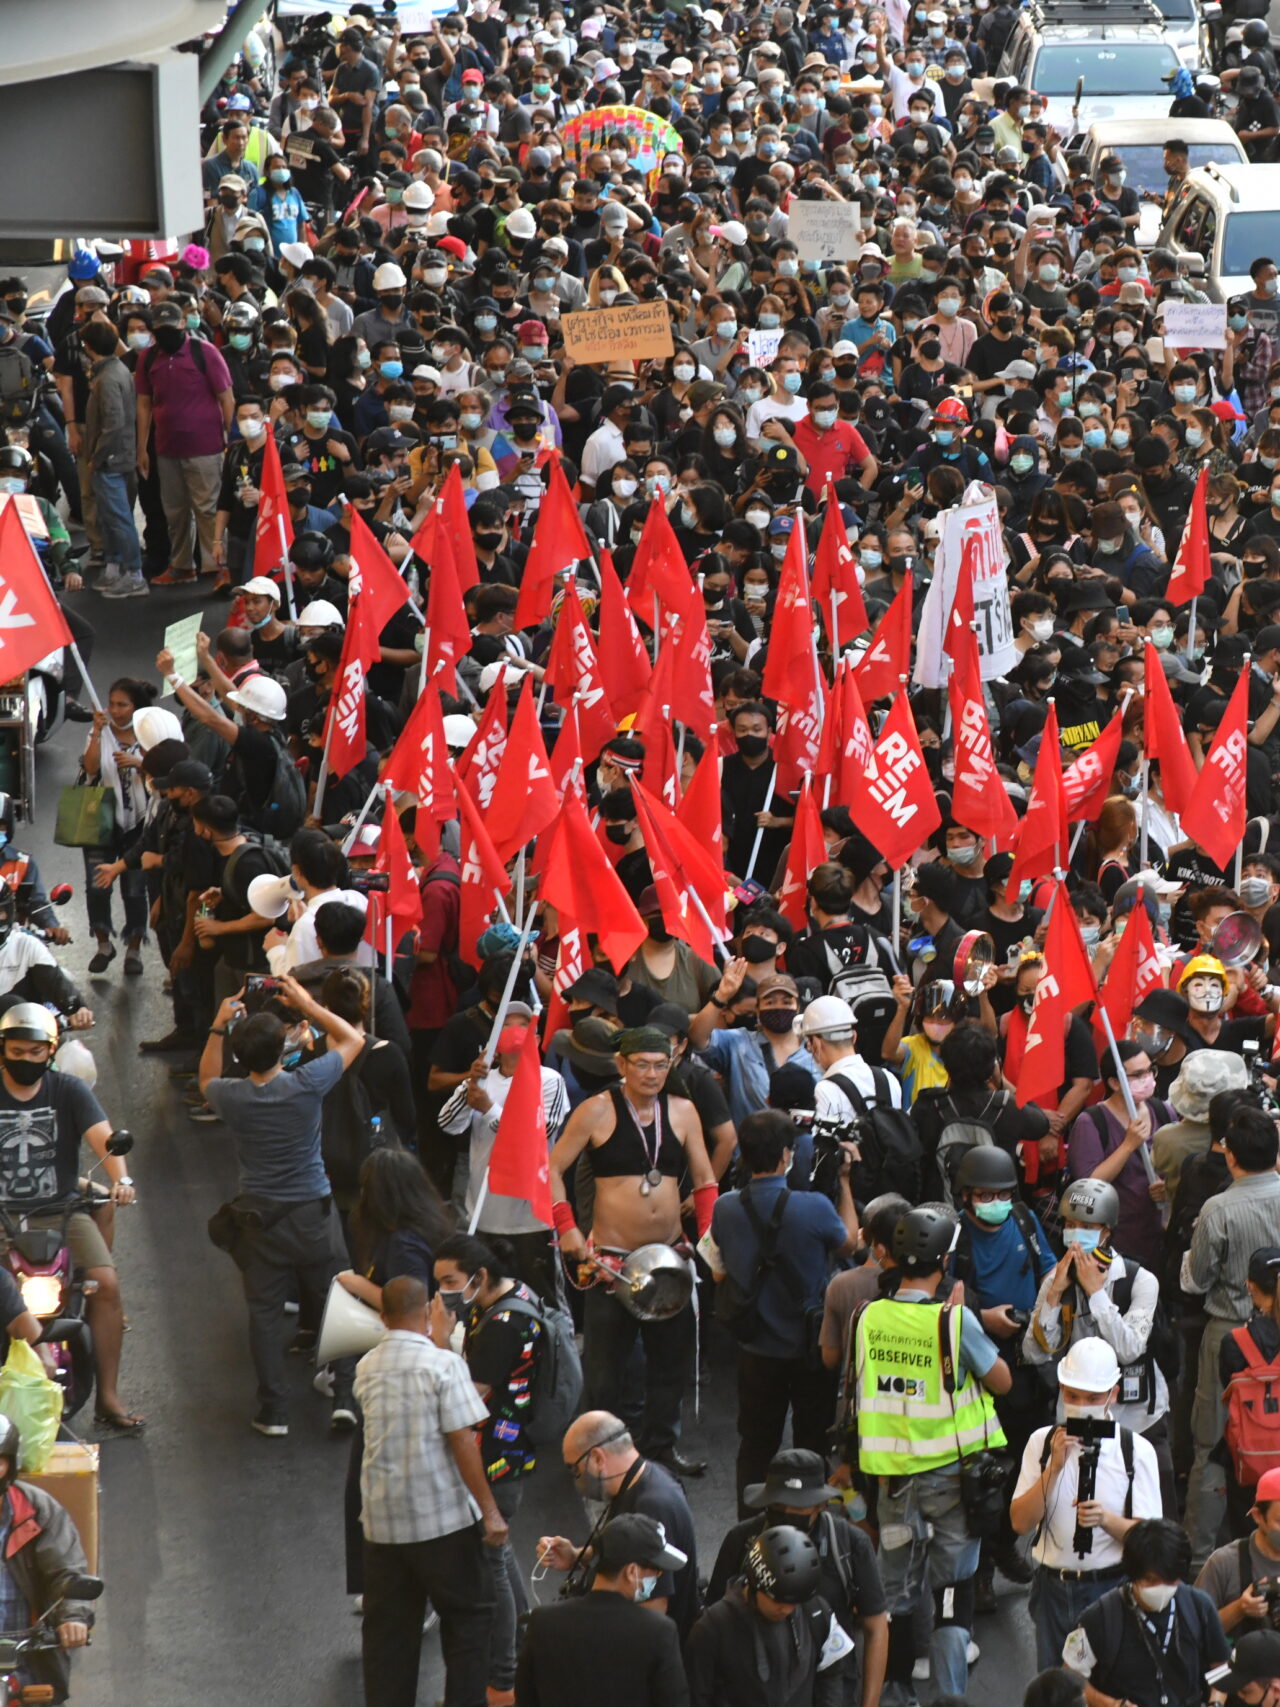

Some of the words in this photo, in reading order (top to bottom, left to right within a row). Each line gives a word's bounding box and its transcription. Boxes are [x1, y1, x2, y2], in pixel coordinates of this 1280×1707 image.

[875, 731, 922, 783] RE
[869, 1347, 932, 1368] OBSERVER
[877, 1375, 917, 1396] MOB
